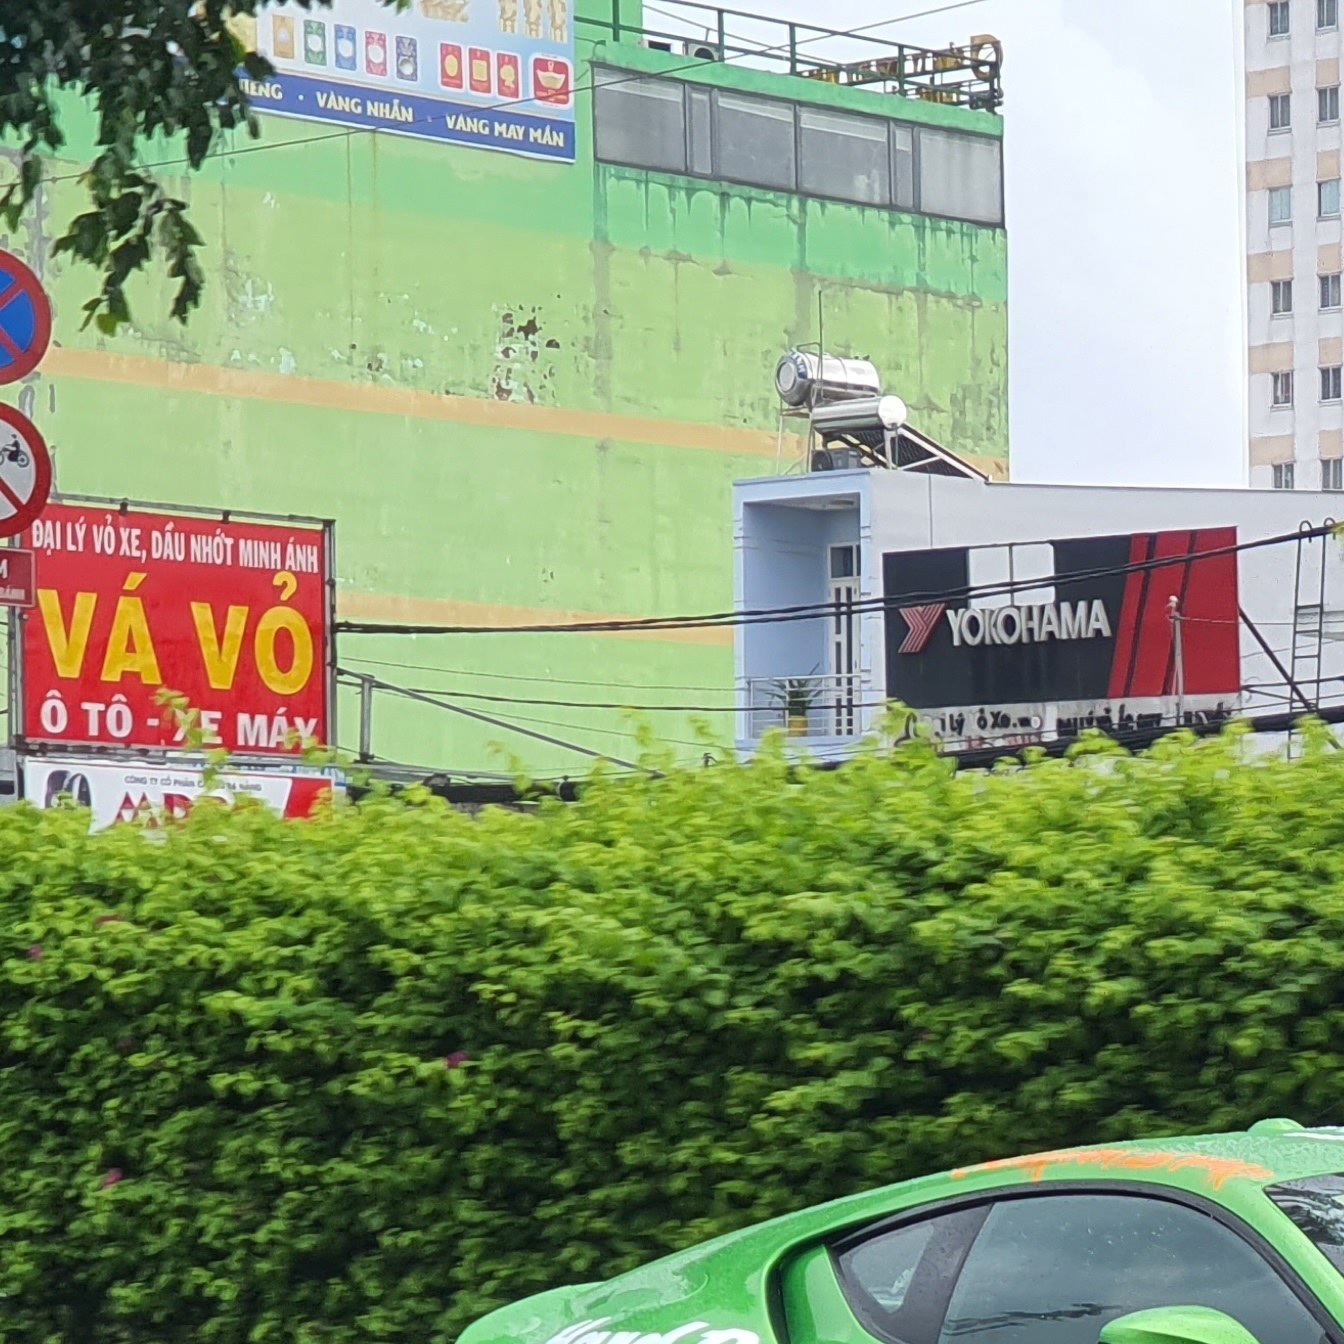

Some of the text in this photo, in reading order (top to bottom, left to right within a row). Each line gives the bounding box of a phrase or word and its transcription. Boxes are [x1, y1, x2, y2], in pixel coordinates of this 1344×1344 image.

[315, 90, 362, 114] VÀNG
[445, 113, 490, 135] VÀNG
[494, 121, 526, 141] MAY
[32, 513, 319, 574] ĐẠI LÝ VỎ XE, DẦU NHỚT MINH ÁNH
[36, 570, 314, 696] VÁ VỎ
[946, 599, 1112, 647] YOKOHAMA
[40, 689, 68, 734] Ô
[81, 693, 134, 738] TÔ
[236, 706, 318, 750] MÁY
